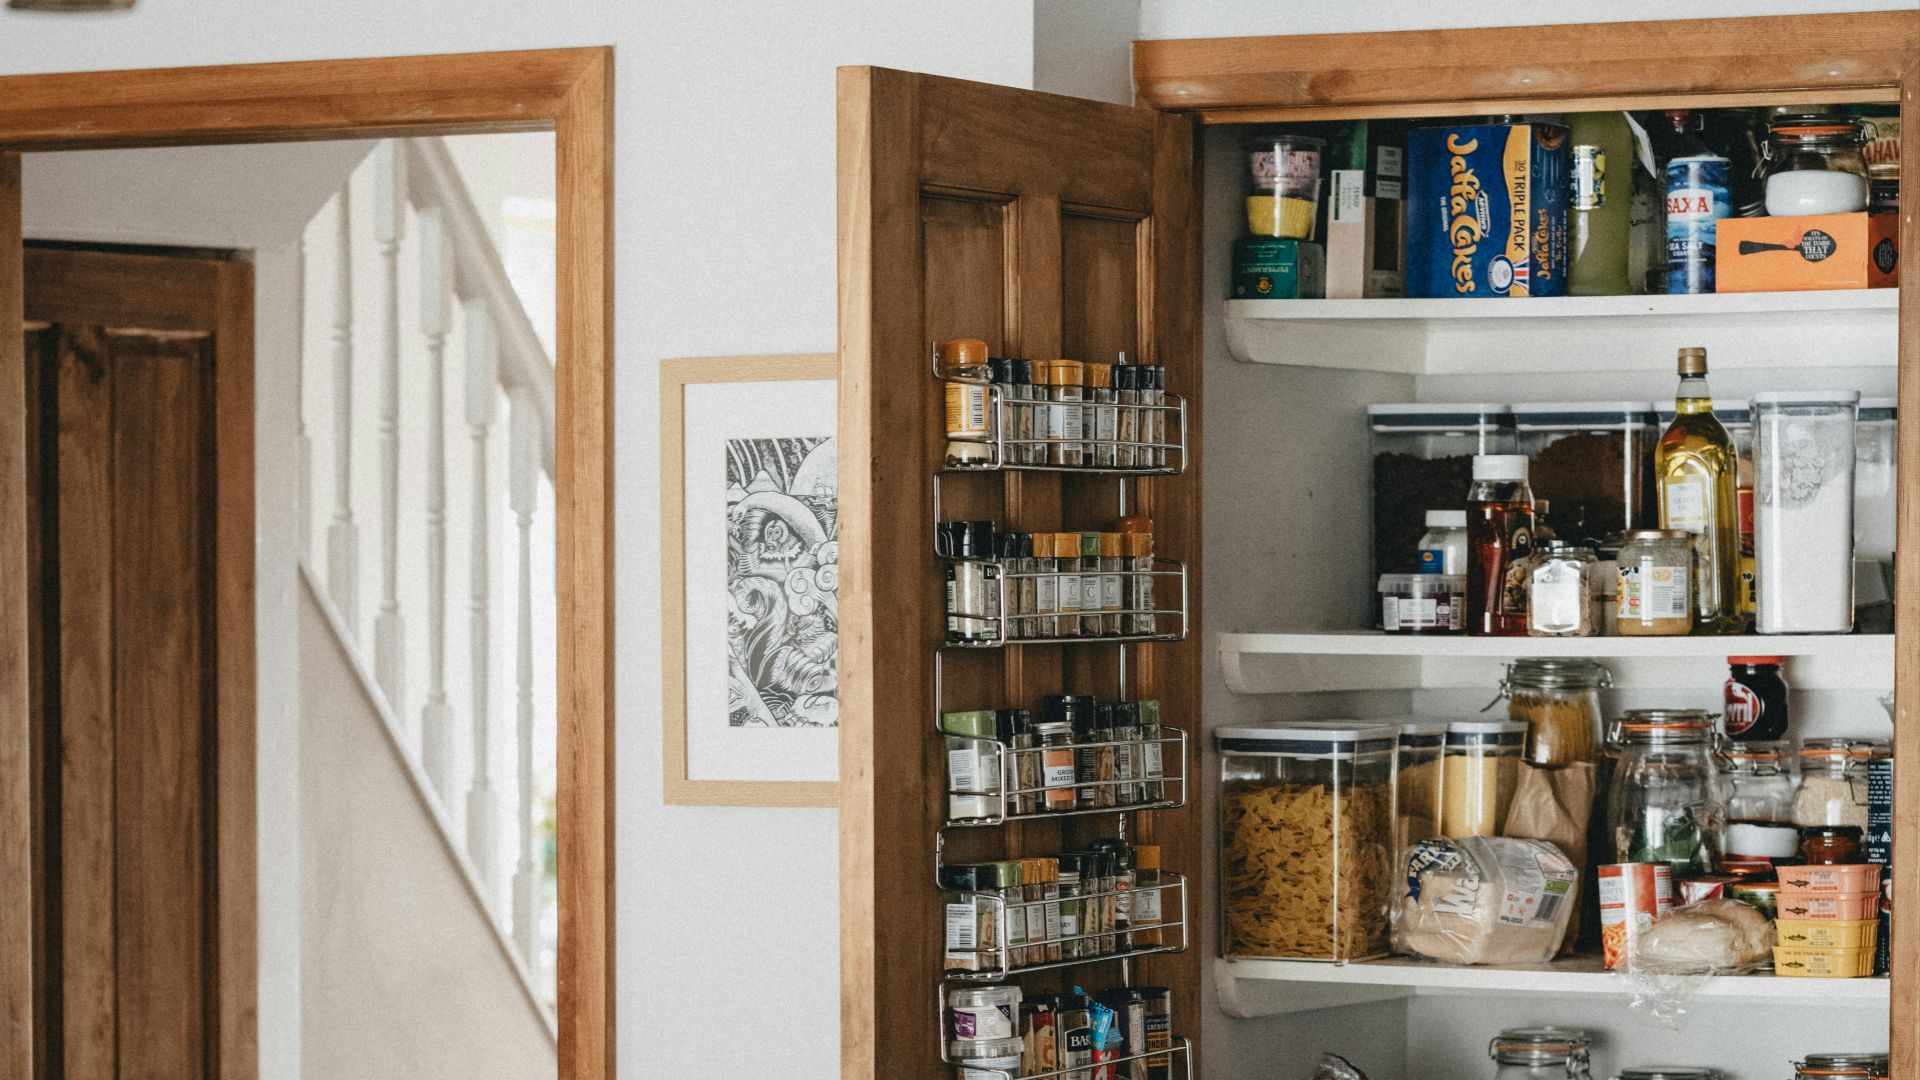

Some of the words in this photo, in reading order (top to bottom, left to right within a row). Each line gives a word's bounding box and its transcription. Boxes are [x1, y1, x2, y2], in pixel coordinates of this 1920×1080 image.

[1447, 133, 1480, 216] Jaffa
[1513, 174, 1526, 215] TRIPLE
[1666, 197, 1709, 214] SAXA
[1513, 219, 1526, 251] PACK
[1804, 246, 1828, 254] THAT
[1450, 215, 1482, 293] Cakes
[1536, 244, 1551, 280] Jaffa
